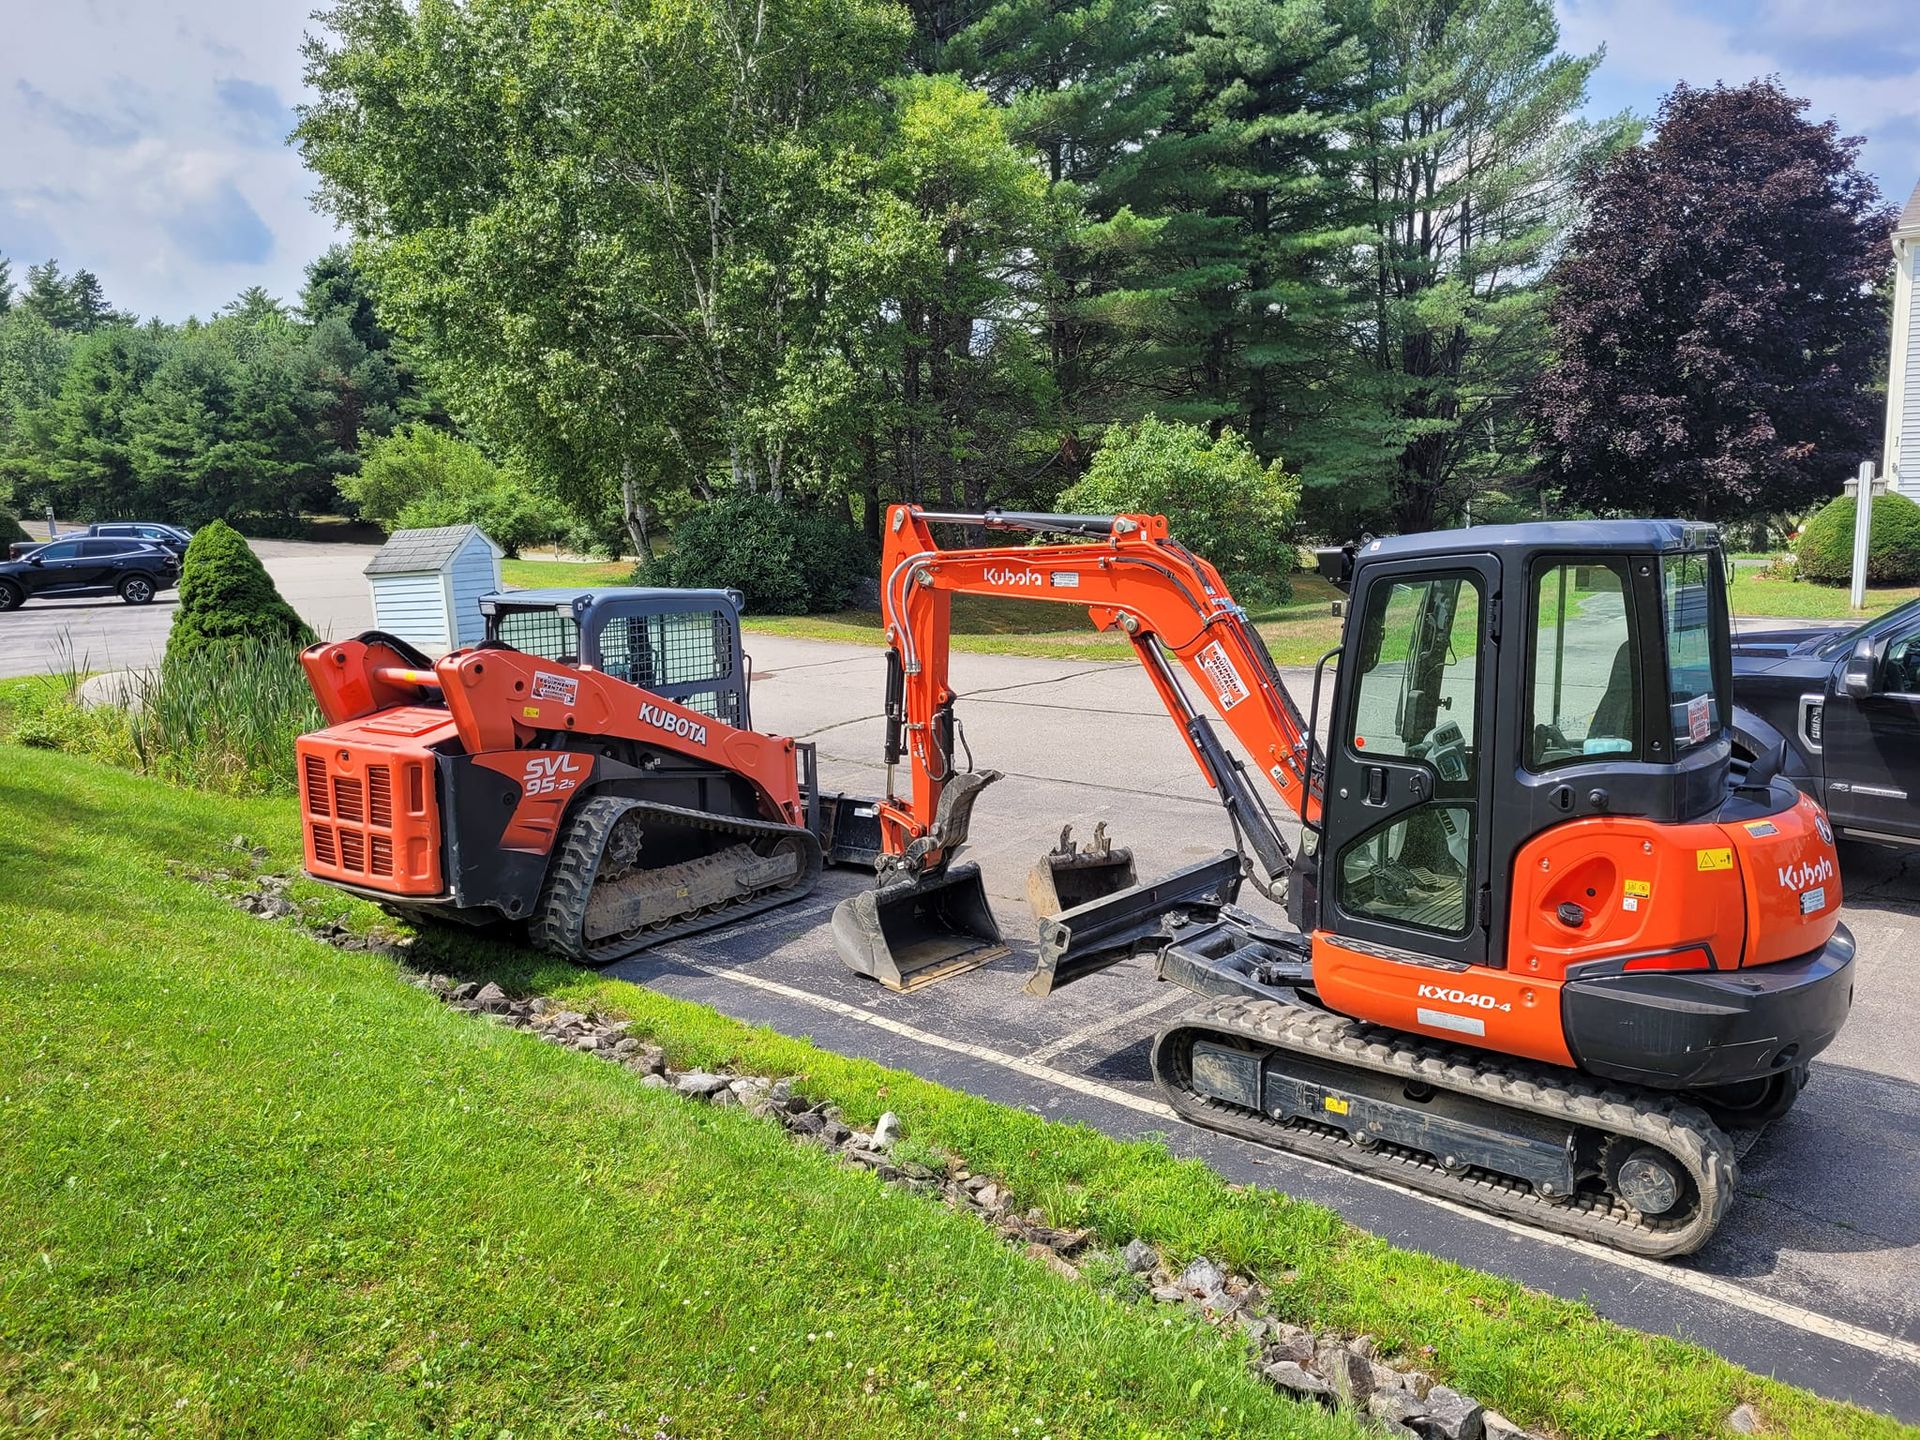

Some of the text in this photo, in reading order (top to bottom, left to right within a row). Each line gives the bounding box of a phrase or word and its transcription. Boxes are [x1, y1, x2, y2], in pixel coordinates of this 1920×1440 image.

[983, 568, 1042, 586] Kubota
[1212, 650, 1241, 693] EQUIPMENT
[1212, 660, 1231, 689] RENTAL
[638, 702, 707, 745] KUBOTA
[523, 753, 580, 780] SVL
[1778, 855, 1833, 891] Kubota
[1417, 984, 1512, 1012] KX040-4
